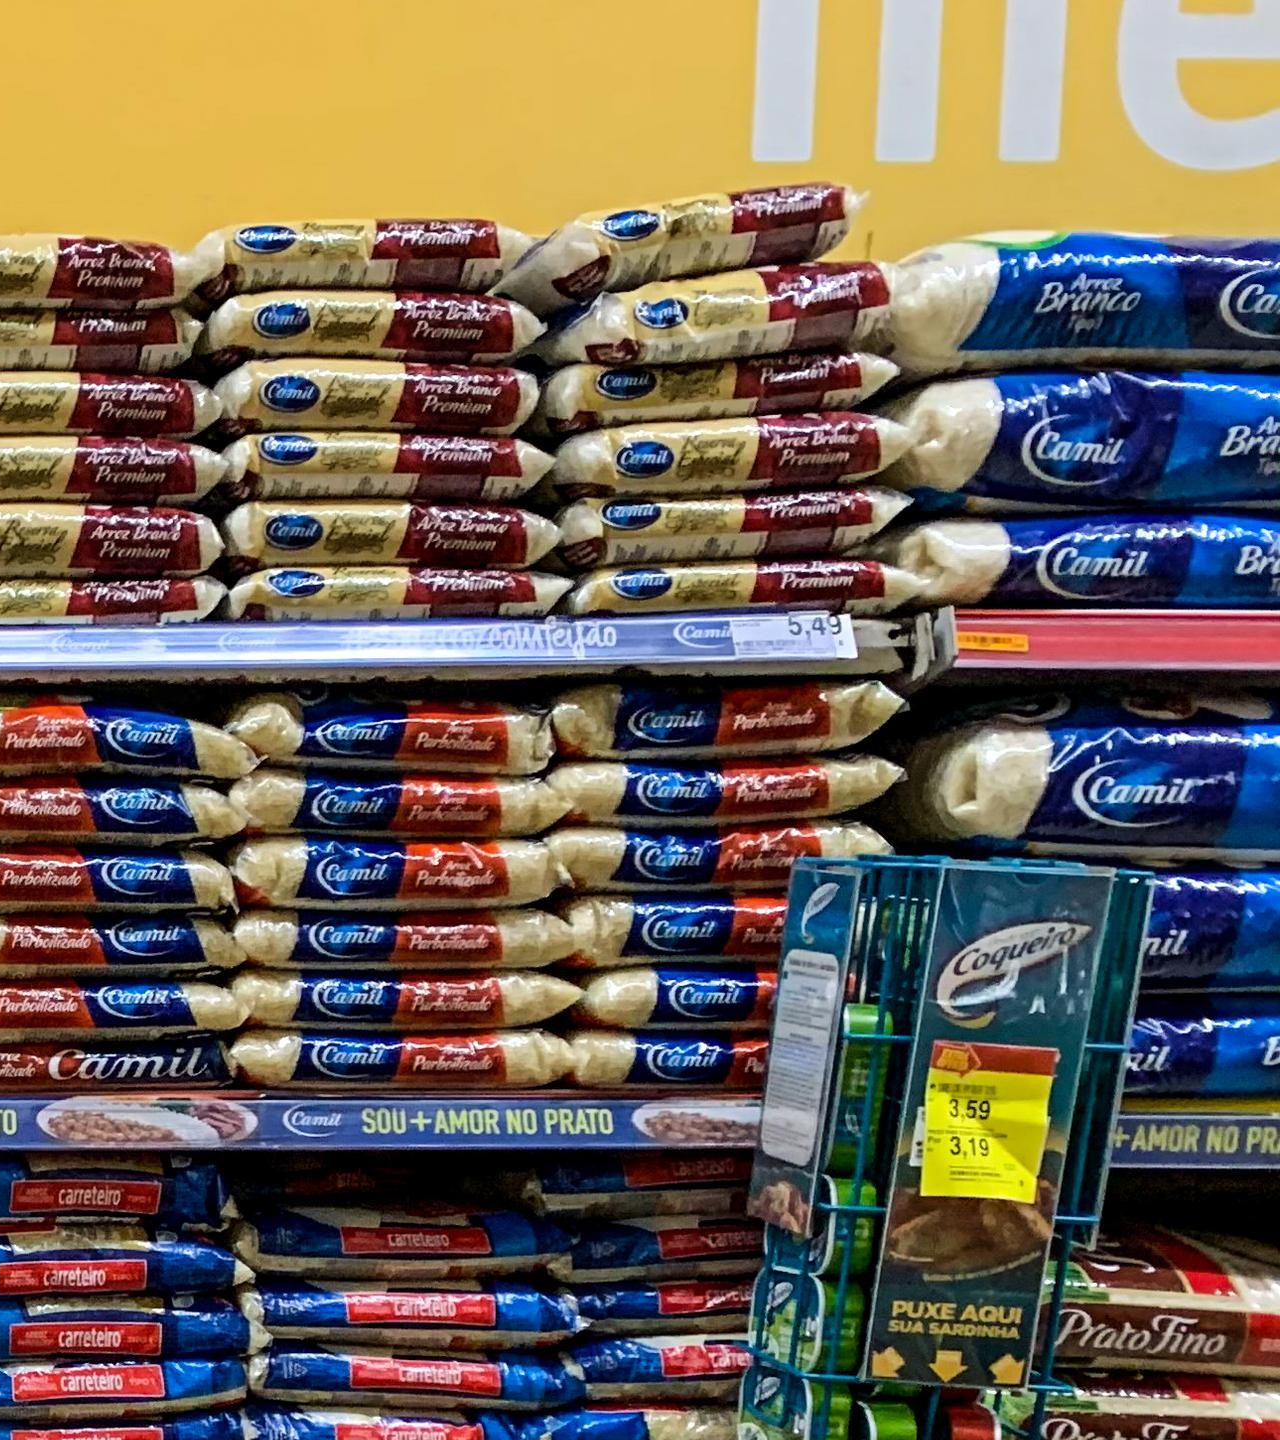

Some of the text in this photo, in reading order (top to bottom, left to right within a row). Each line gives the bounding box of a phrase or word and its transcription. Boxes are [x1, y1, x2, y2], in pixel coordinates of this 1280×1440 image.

[1070, 273, 1122, 293] Arroz
[1036, 288, 1142, 315] Branco
[268, 383, 315, 402] Camil
[421, 398, 491, 417] Premium
[1035, 432, 1124, 466] Camil
[100, 541, 169, 560] Premium
[1052, 549, 1147, 579] Camil
[787, 613, 842, 637] 5,49
[4, 732, 86, 750] Parboilizado
[1089, 777, 1197, 805] Camil
[1, 869, 82, 888] Parboilizado
[953, 924, 1079, 977] Coqueiro
[48, 1047, 209, 1079] Camil
[506, 1108, 537, 1136] NO
[543, 1107, 614, 1136] PRATO
[949, 1100, 990, 1122] 3,59
[949, 1137, 990, 1160] 3,19
[1208, 1126, 1237, 1153] NO
[57, 1185, 121, 1208] carreteiro
[891, 1300, 1023, 1325] PUXE AQUI
[887, 1319, 1020, 1340] SUA SARDINHA
[59, 1370, 124, 1394] carreteiro
